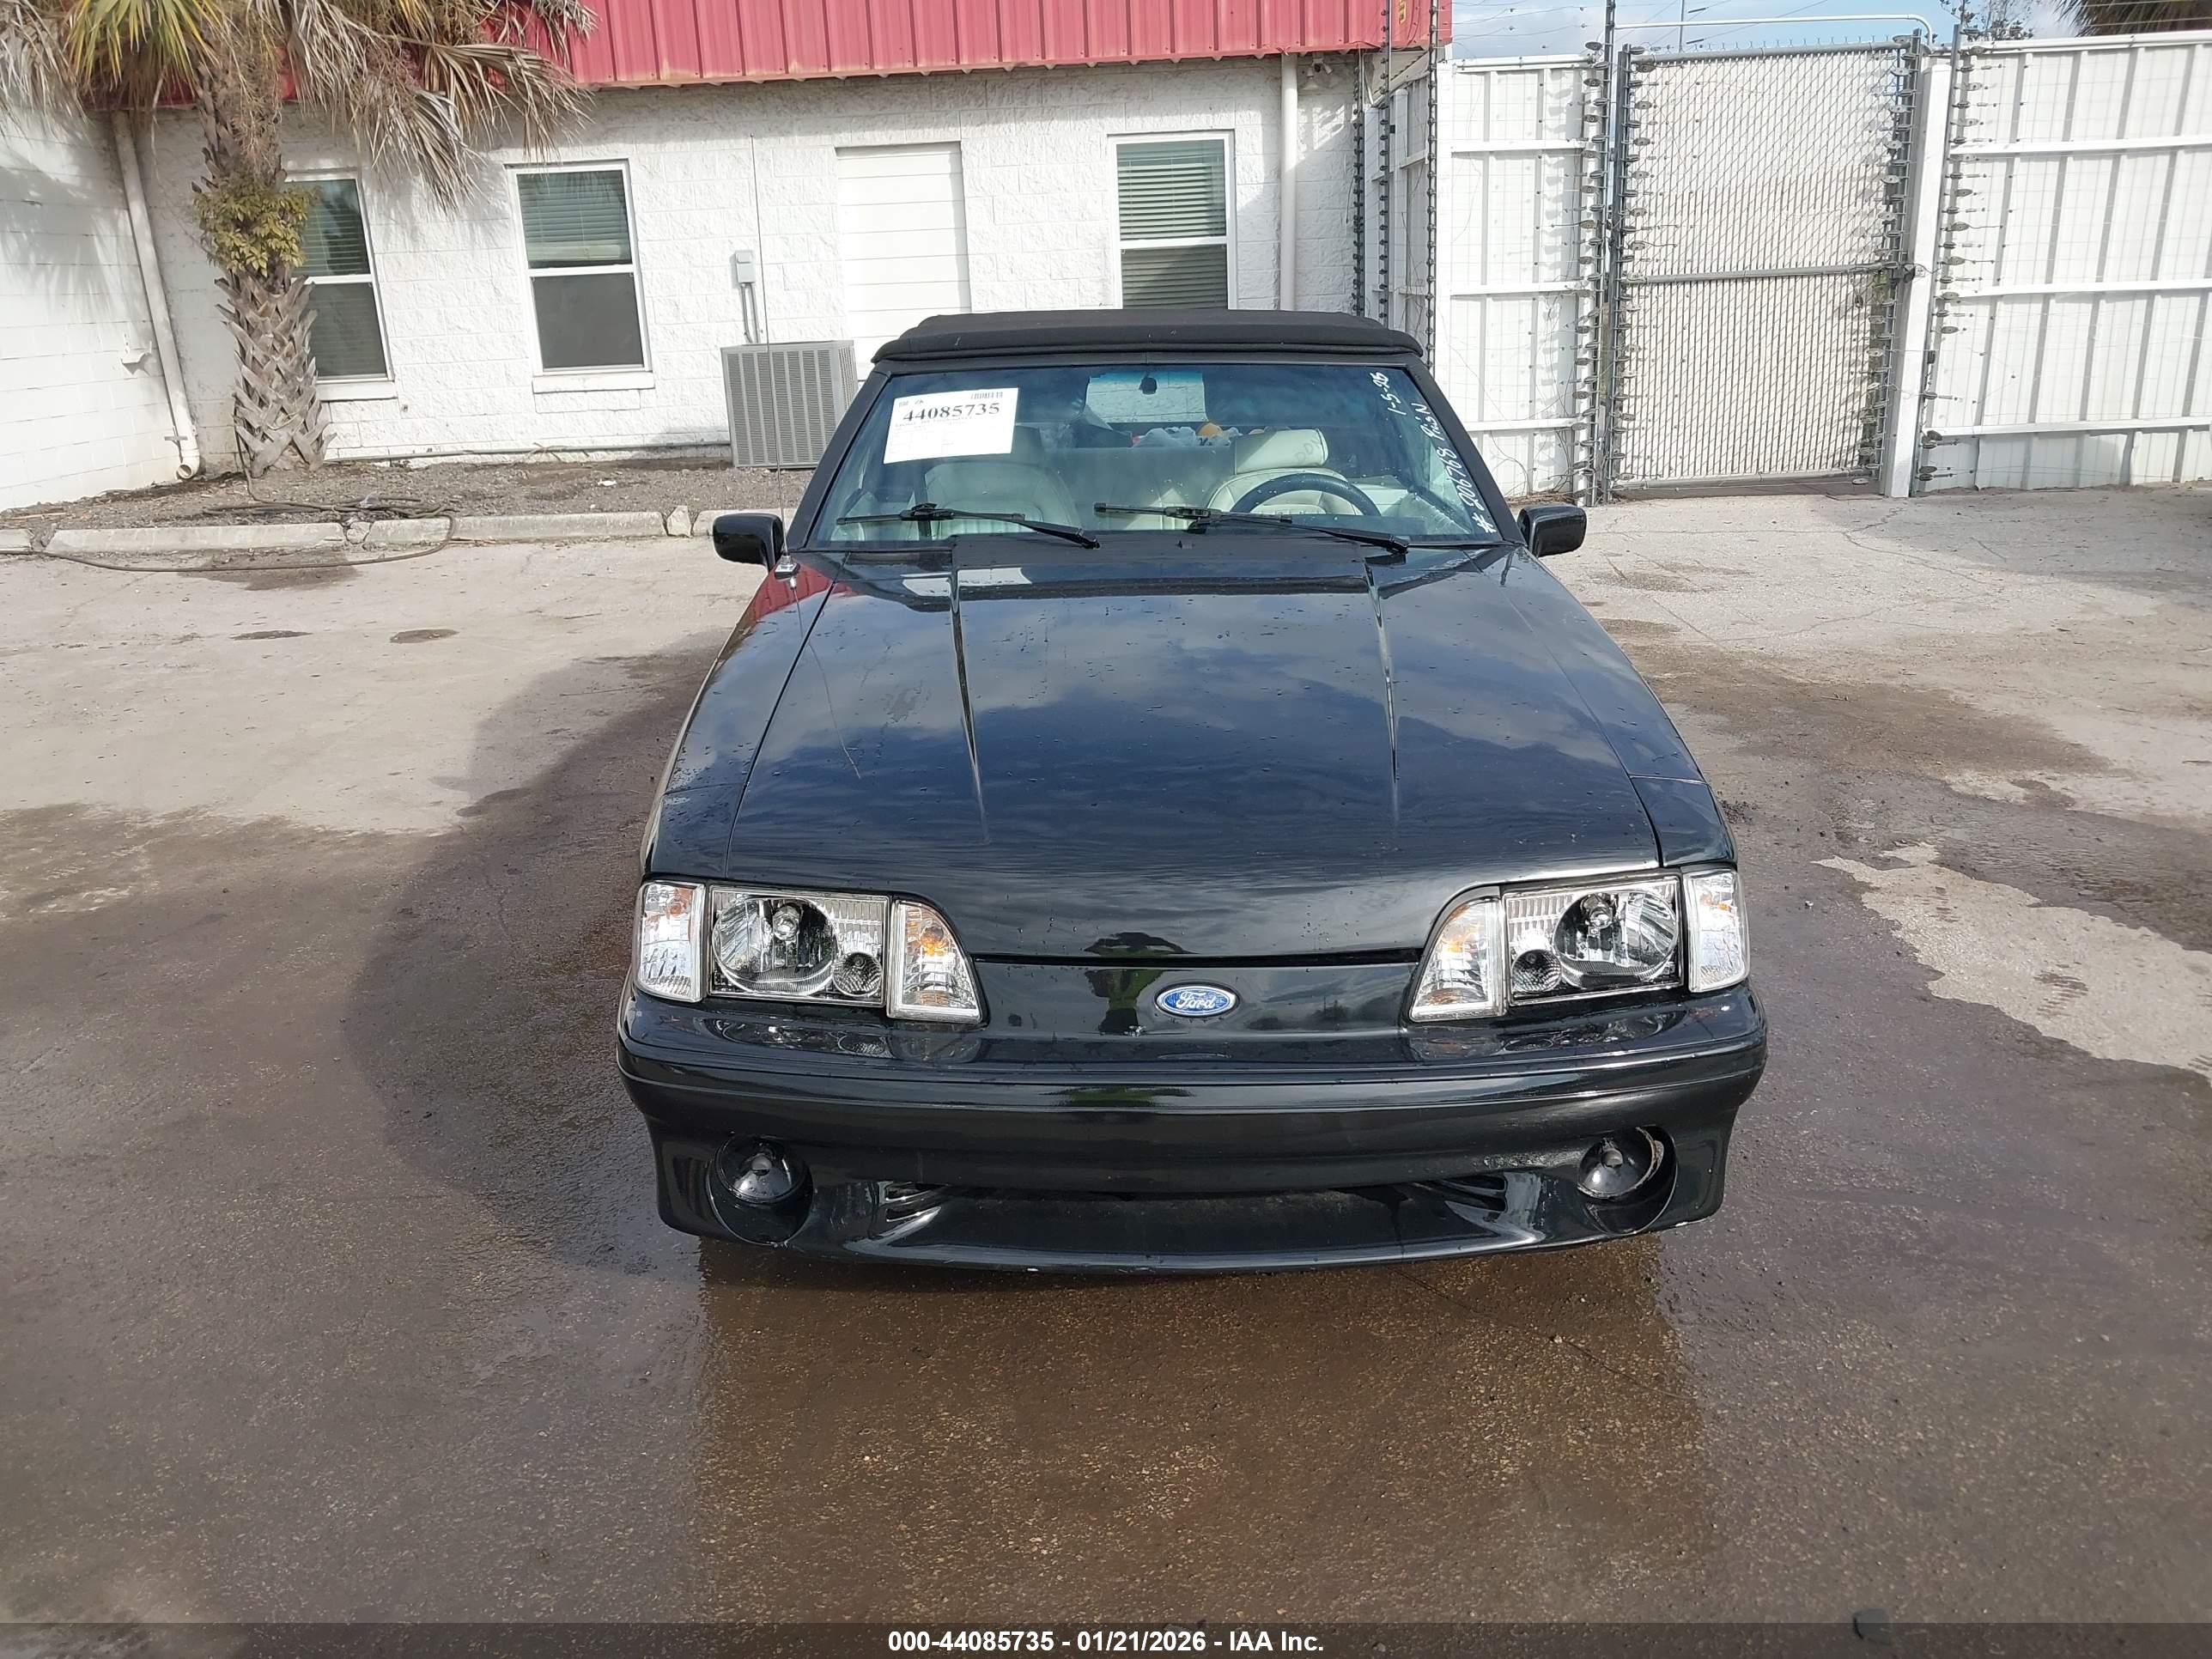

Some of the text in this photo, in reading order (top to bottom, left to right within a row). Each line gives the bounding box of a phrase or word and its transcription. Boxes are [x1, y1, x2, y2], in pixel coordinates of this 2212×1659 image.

[903, 403, 1000, 422] 44085735
[1437, 447, 1485, 511] 206768
[1176, 991, 1216, 1009] Ford
